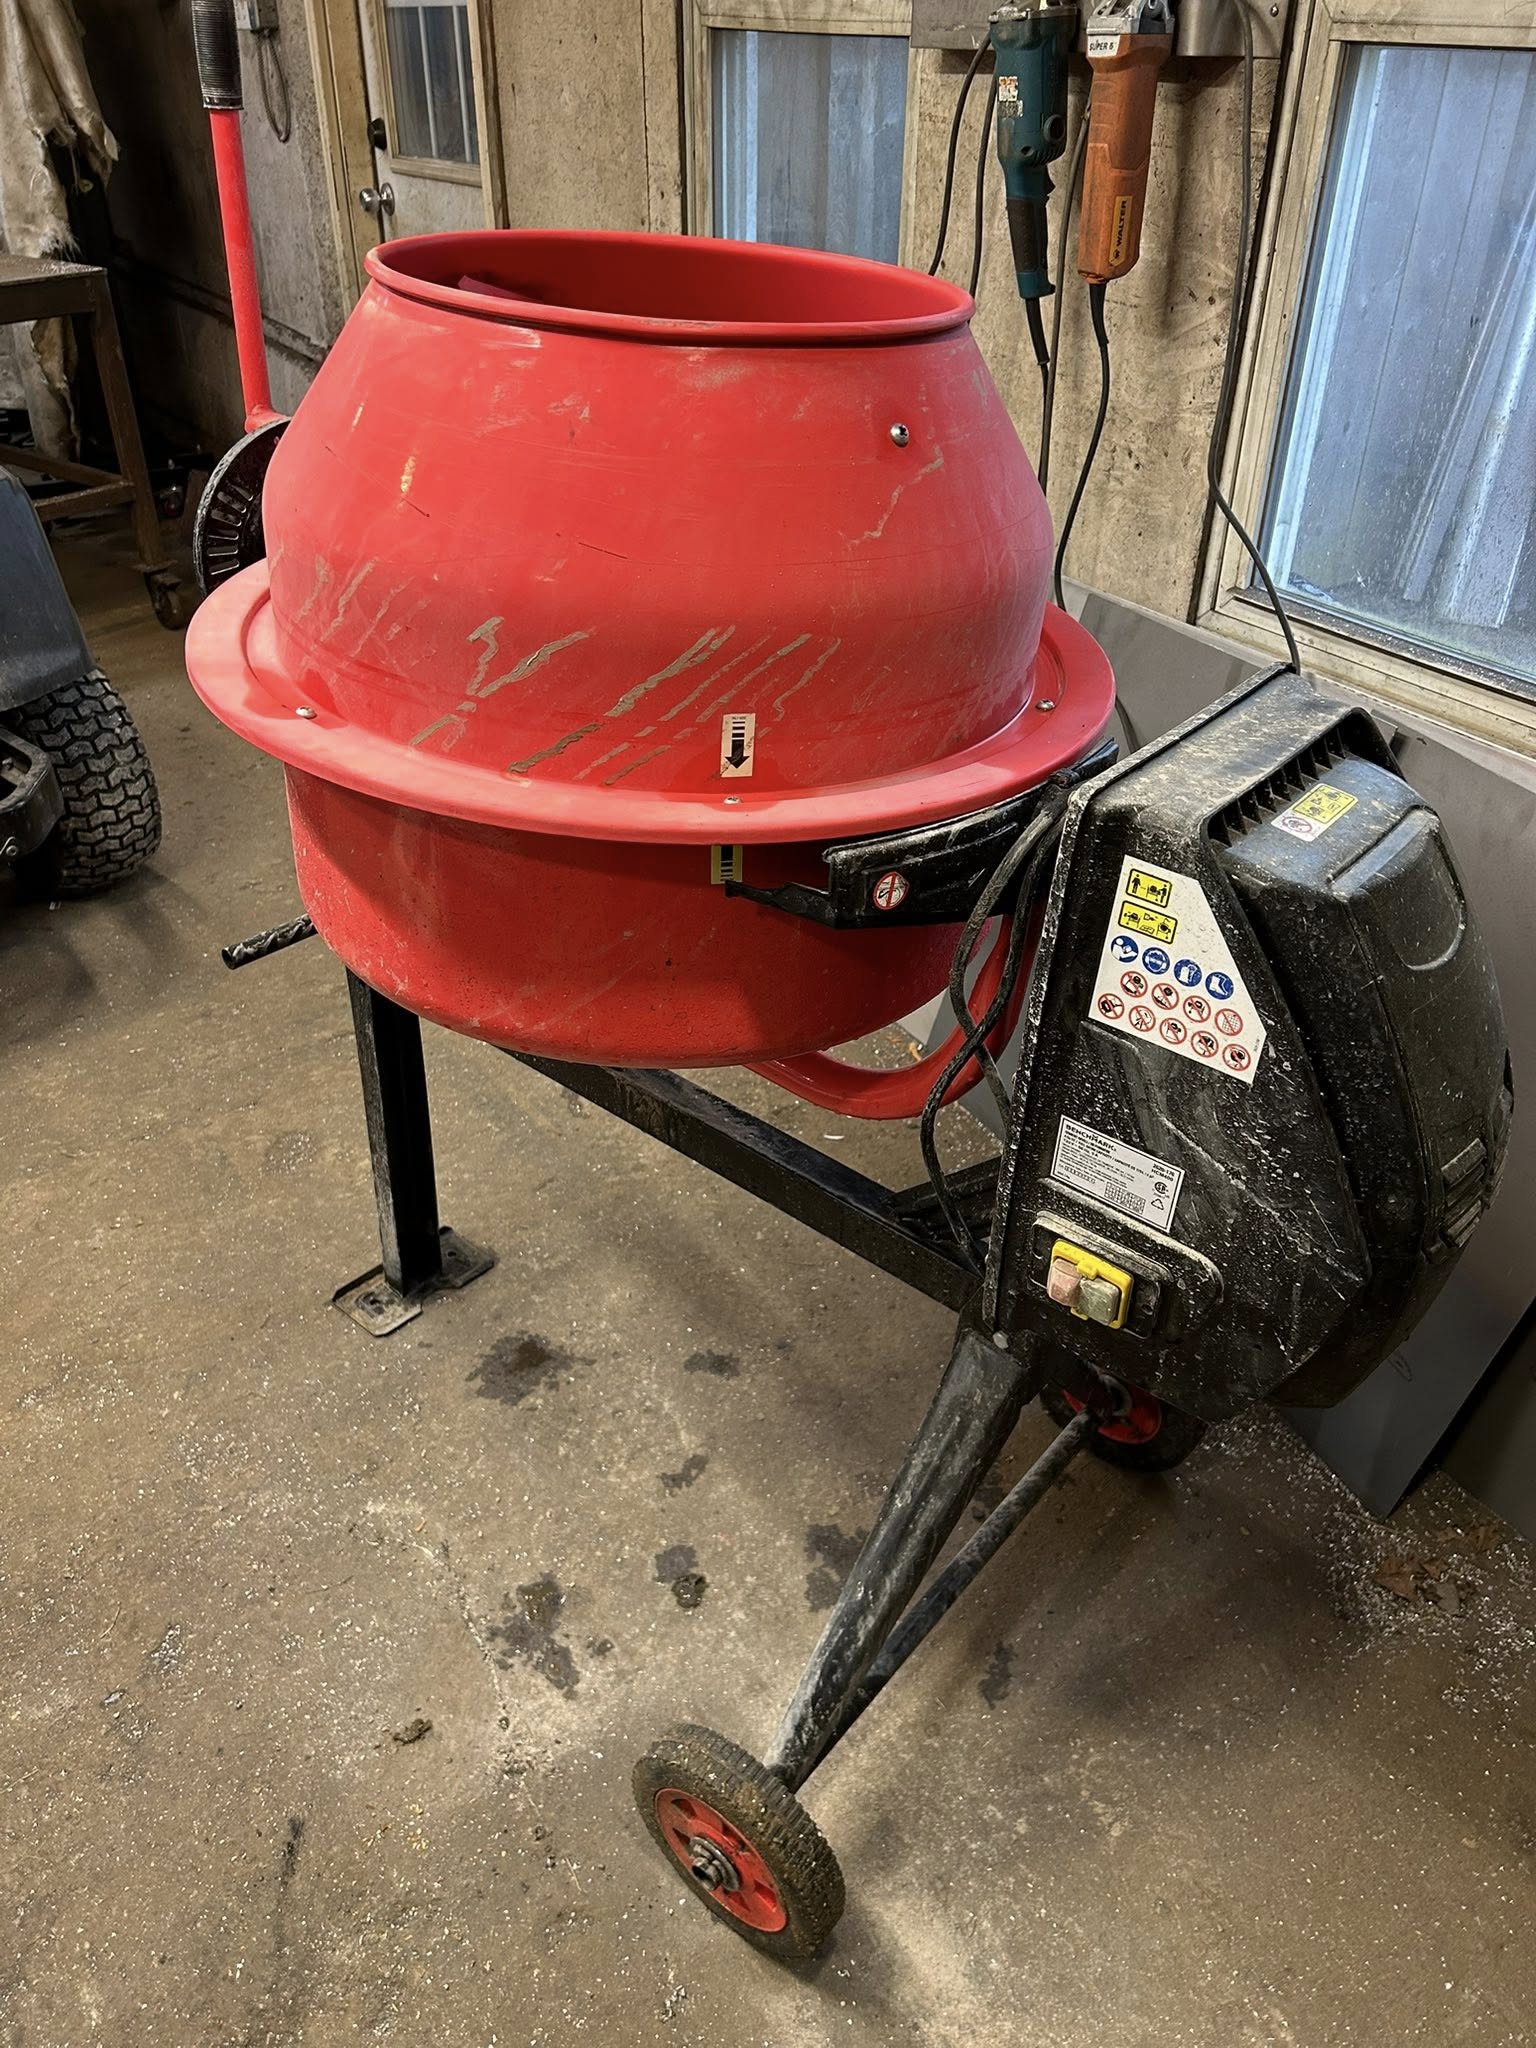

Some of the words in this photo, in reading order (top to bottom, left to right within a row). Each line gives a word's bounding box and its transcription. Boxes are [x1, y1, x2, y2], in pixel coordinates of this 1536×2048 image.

[1089, 40, 1108, 51] SUPER
[1116, 200, 1127, 247] WALTER
[1066, 1124, 1116, 1151] BENCHMARK
